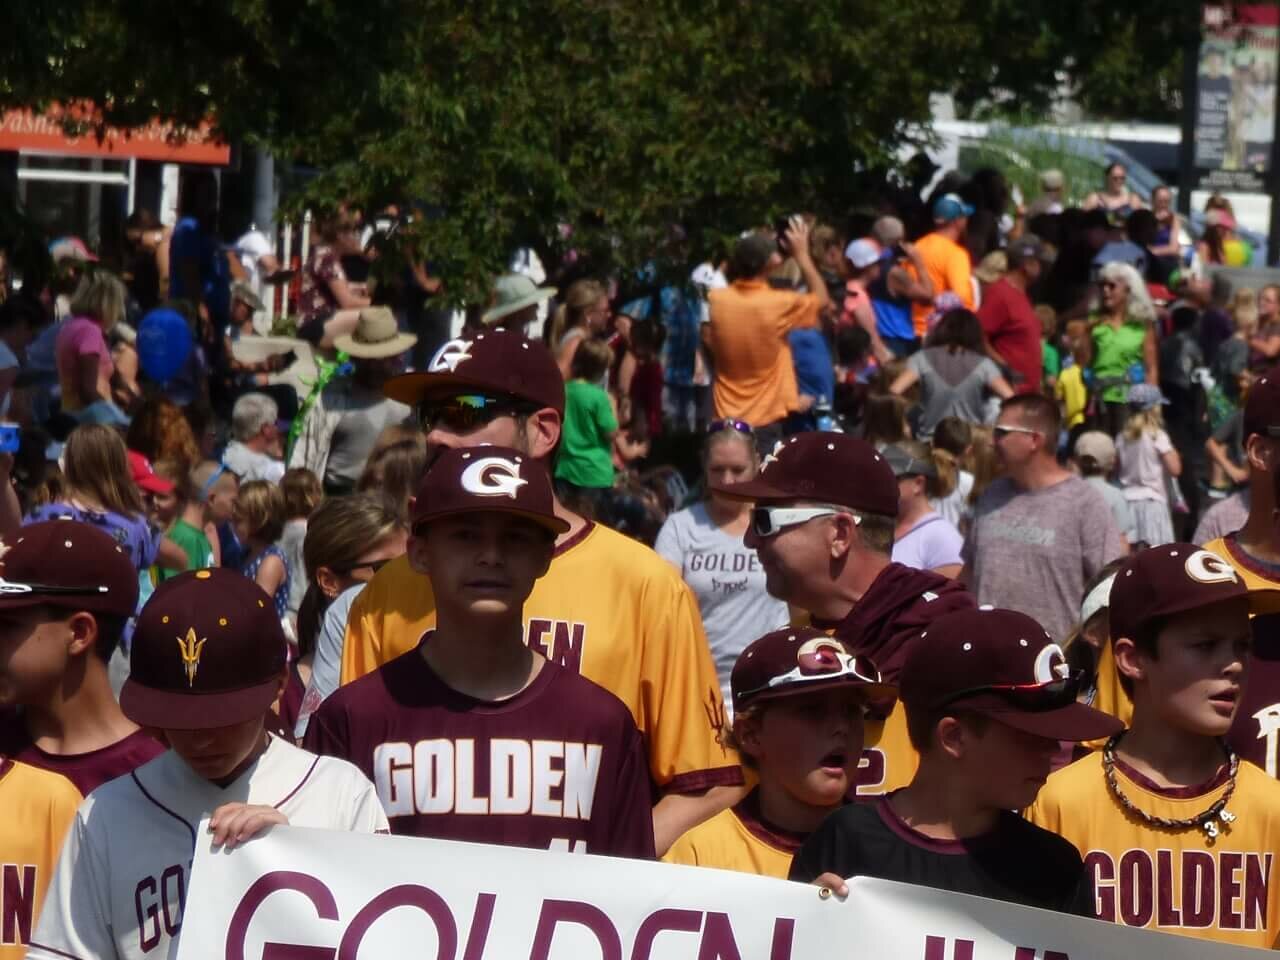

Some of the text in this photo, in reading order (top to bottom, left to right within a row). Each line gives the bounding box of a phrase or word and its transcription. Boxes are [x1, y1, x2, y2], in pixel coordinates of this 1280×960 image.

[461, 457, 528, 499] G
[690, 552, 761, 573] GOLDE
[373, 738, 603, 820] GOLDEN
[1084, 849, 1273, 932] GOLDEN
